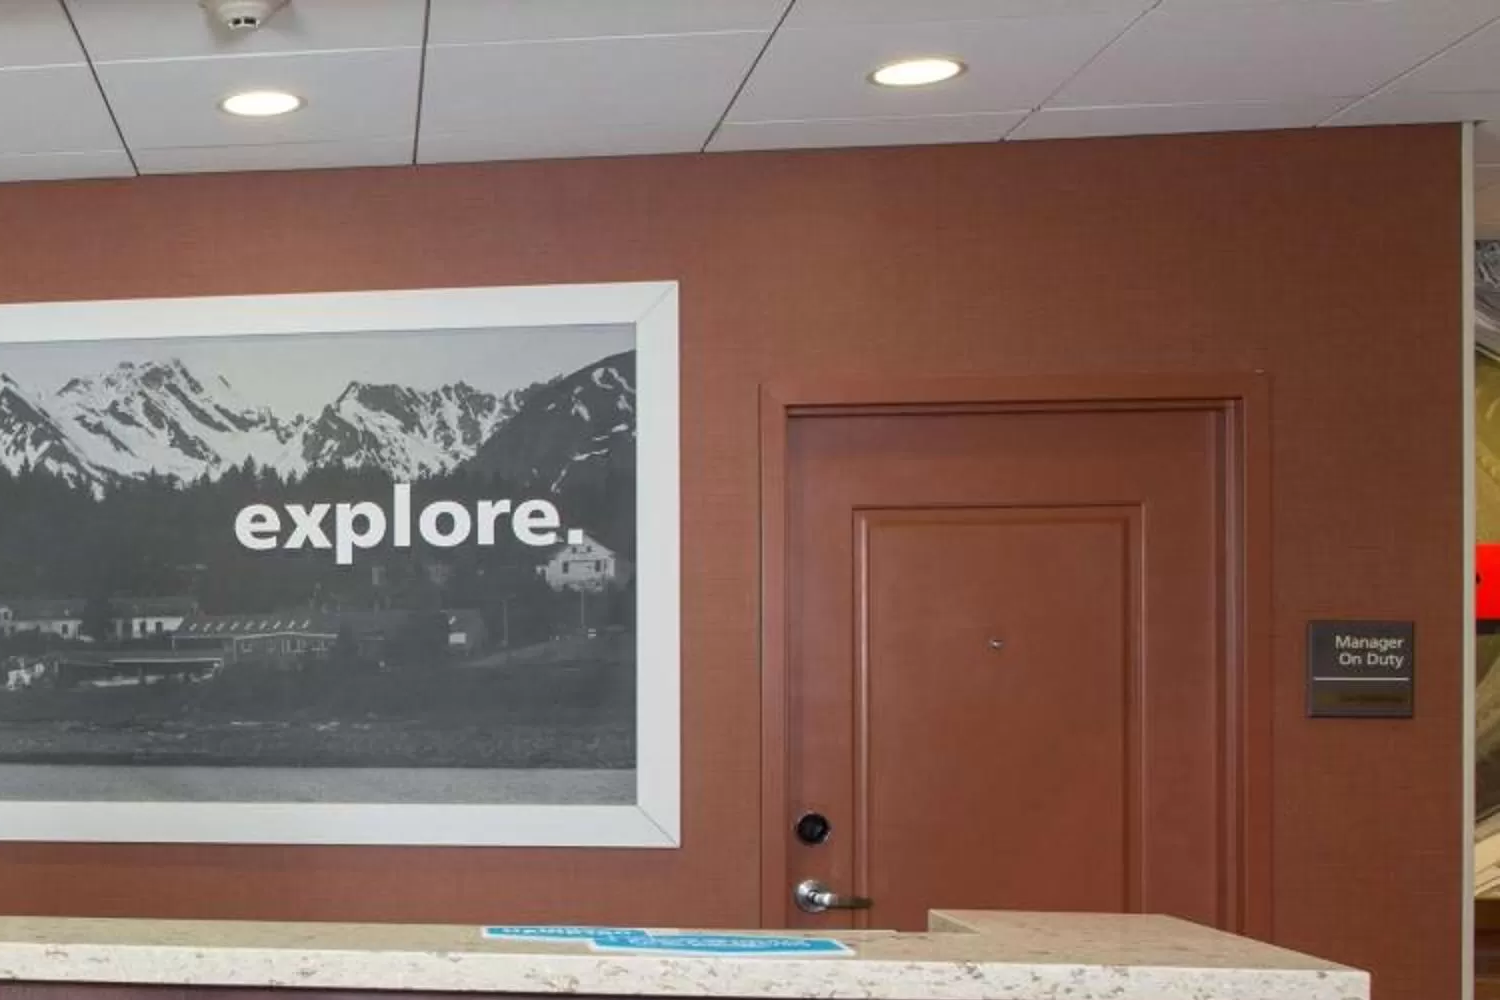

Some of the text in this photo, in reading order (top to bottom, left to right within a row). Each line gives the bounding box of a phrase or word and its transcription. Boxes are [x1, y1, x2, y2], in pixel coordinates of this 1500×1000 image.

[234, 483, 584, 565] explore.
[1334, 635, 1405, 652] Manager
[1339, 652, 1405, 669] On Duty
